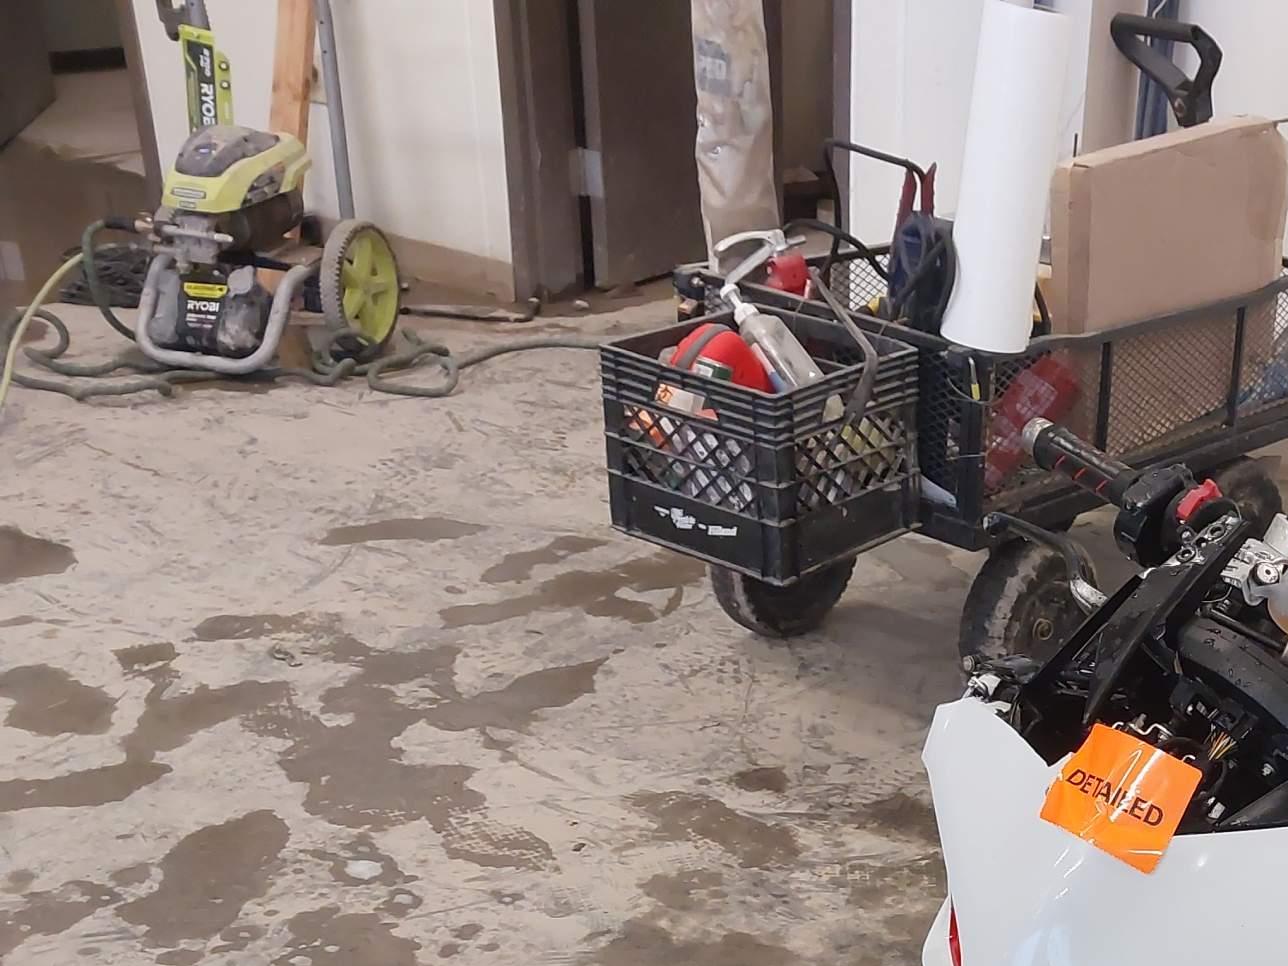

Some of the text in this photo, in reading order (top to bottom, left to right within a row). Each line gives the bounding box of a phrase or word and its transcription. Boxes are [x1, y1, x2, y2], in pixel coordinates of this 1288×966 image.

[200, 82, 217, 126] RYOB
[187, 299, 220, 312] RYOBI
[1066, 768, 1164, 827] DETAILED
